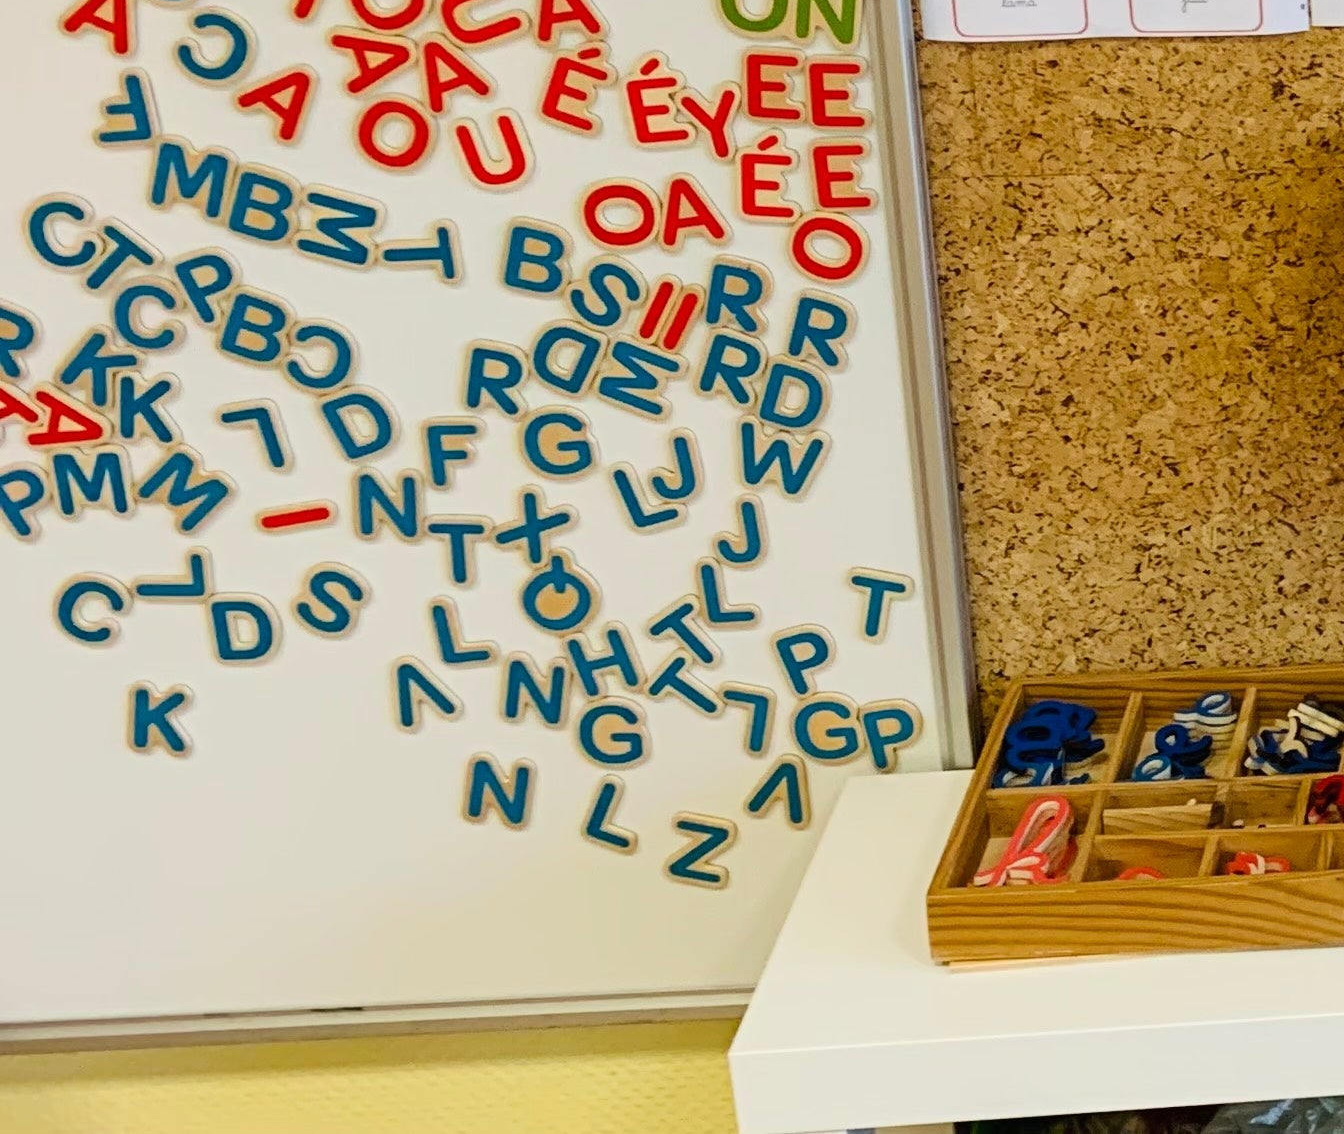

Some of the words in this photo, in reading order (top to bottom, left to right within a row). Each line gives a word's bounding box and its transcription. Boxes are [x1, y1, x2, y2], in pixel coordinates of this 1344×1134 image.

[455, 115, 526, 185] U
[504, 227, 564, 294] B
[427, 424, 477, 487] F
[742, 422, 823, 495] W
[211, 600, 274, 661] D
[297, 570, 363, 633] S
[851, 575, 906, 637] T
[133, 688, 186, 753] K
[468, 760, 530, 824] N
[668, 820, 729, 883] Z
